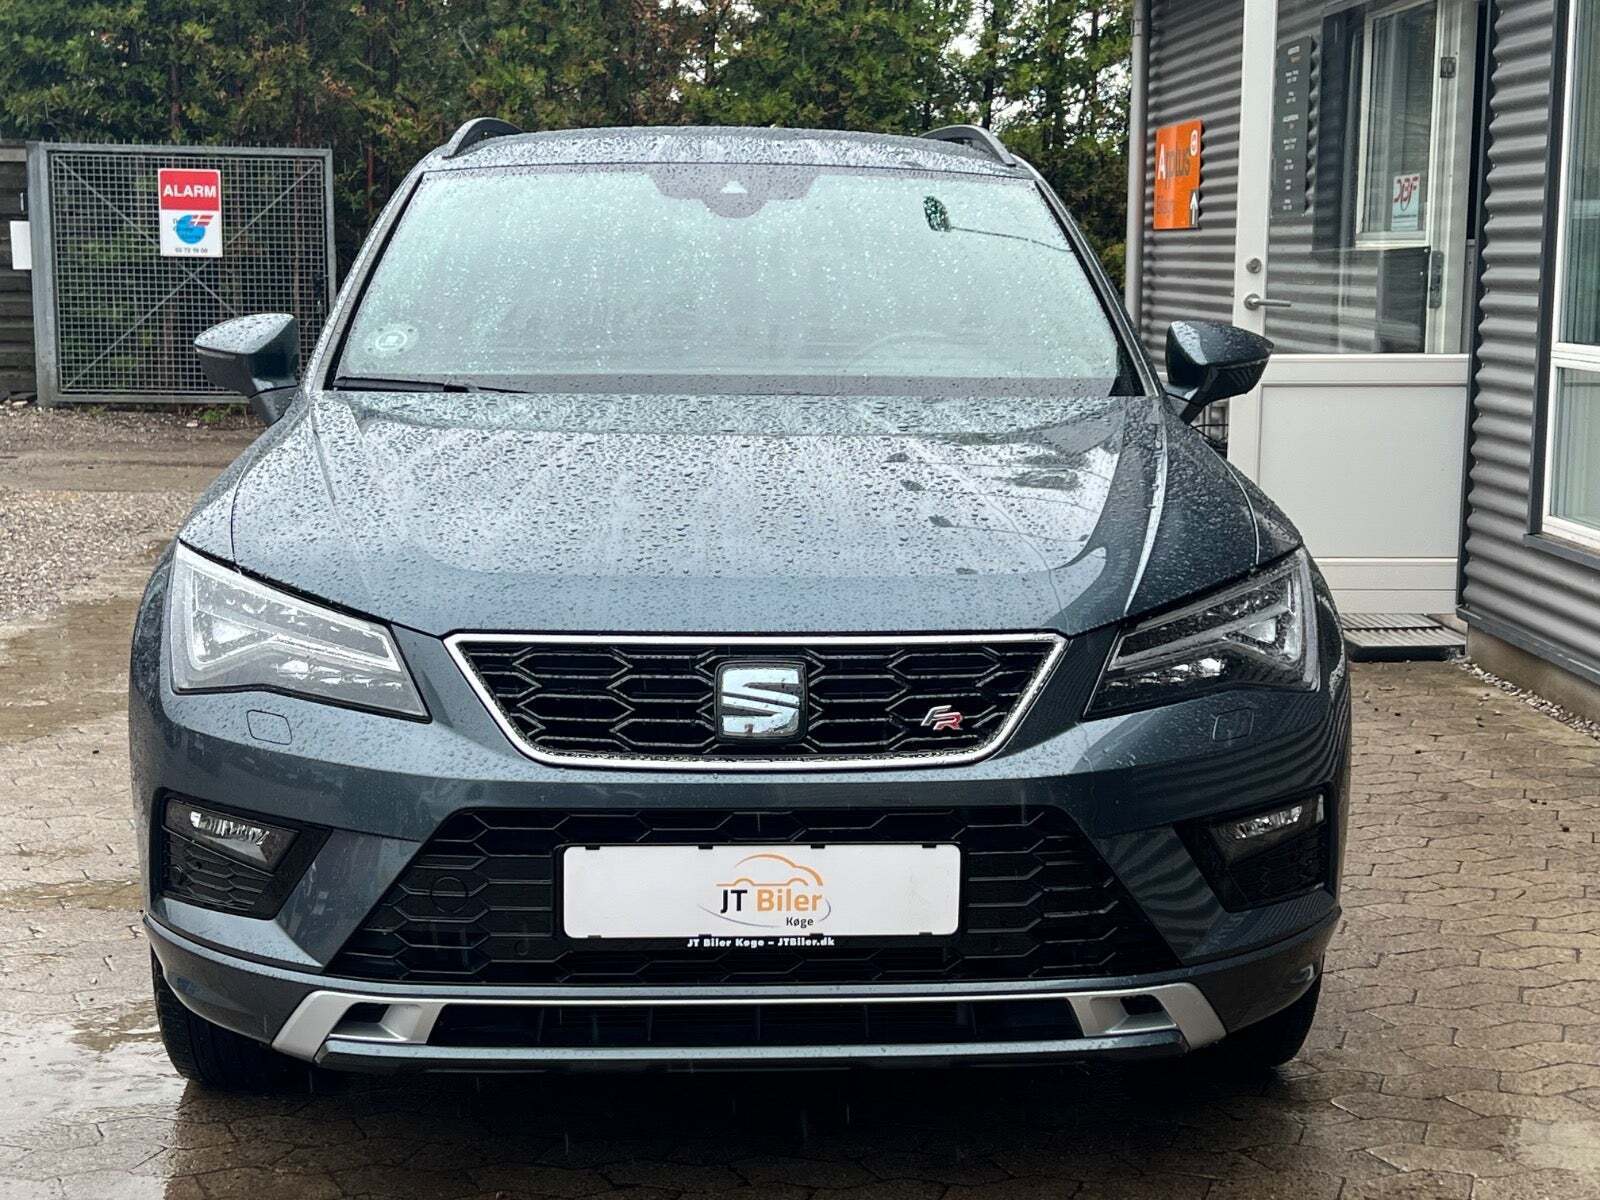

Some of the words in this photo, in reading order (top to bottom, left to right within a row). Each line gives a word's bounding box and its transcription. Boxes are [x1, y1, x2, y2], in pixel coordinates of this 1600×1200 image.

[162, 184, 217, 198] ALARM
[720, 889, 748, 913] JT
[756, 888, 822, 911] Biler
[785, 917, 814, 928] Køge
[687, 938, 700, 948] JT
[703, 938, 732, 947] Biler
[777, 937, 835, 947] JTBiler.dk
